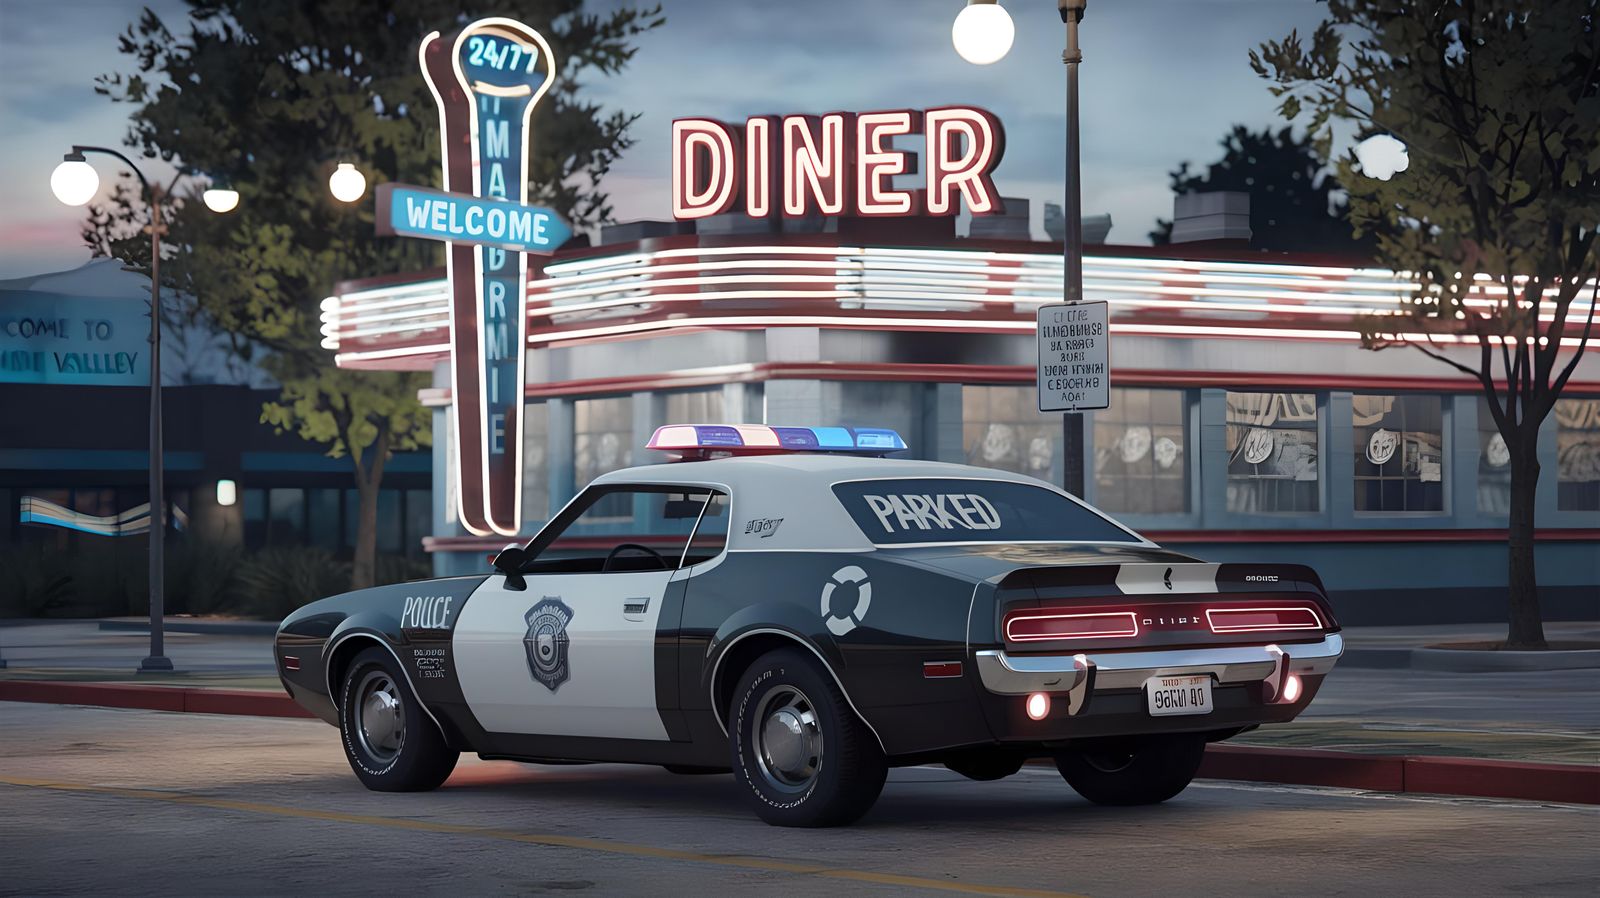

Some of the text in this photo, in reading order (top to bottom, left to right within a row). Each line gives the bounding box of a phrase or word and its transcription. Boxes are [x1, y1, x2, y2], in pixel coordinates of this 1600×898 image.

[468, 36, 539, 75] 24/77
[672, 107, 997, 219] DINER
[406, 196, 550, 245] WELCOME
[863, 494, 1002, 533] PARKED
